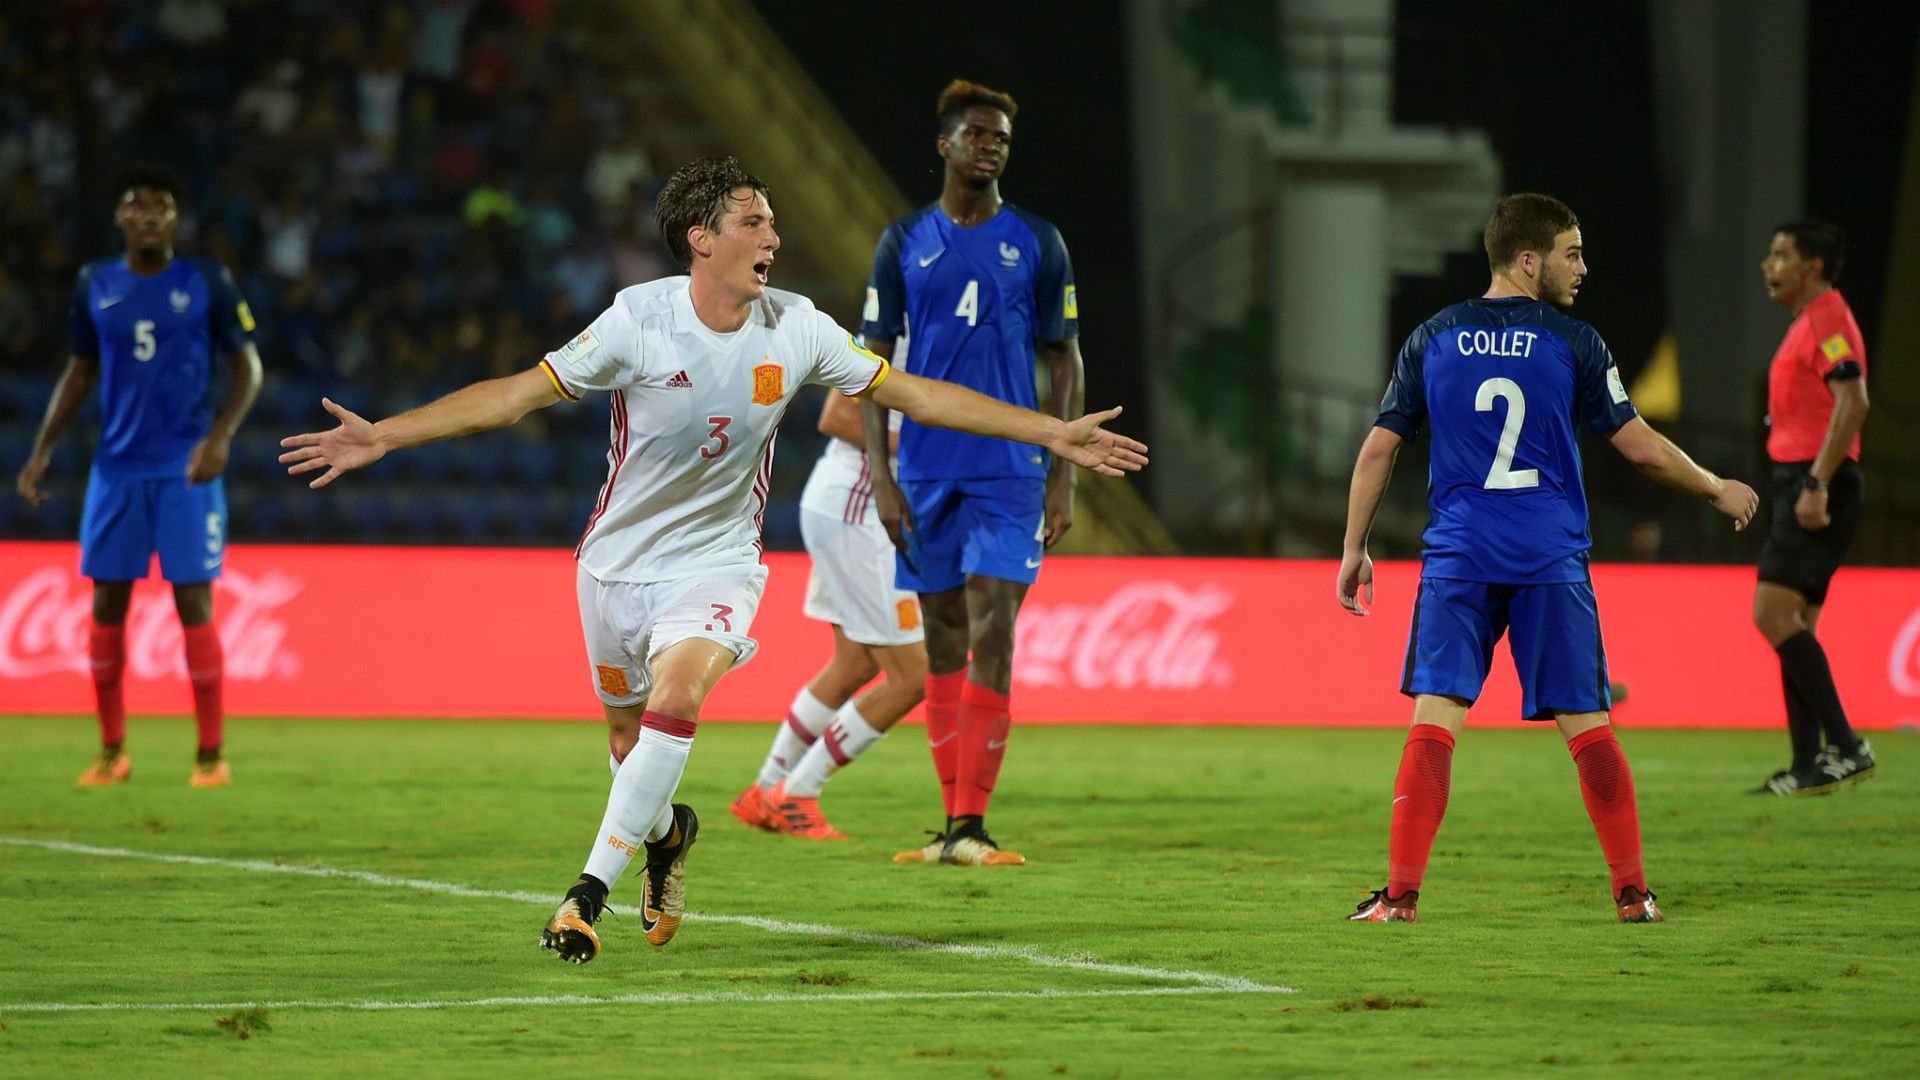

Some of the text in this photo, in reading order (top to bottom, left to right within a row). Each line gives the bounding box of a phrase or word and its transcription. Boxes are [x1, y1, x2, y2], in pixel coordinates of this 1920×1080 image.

[955, 280, 979, 327] 4
[133, 320, 157, 362] 5
[1457, 329, 1537, 358] COLLET
[665, 380, 693, 388] adidas
[700, 416, 732, 459] 3
[1475, 377, 1539, 489] 2
[207, 511, 221, 552] 5
[0, 566, 305, 680] Coc-Cla
[704, 603, 733, 633] 3
[1014, 581, 1237, 689] ca-Cola
